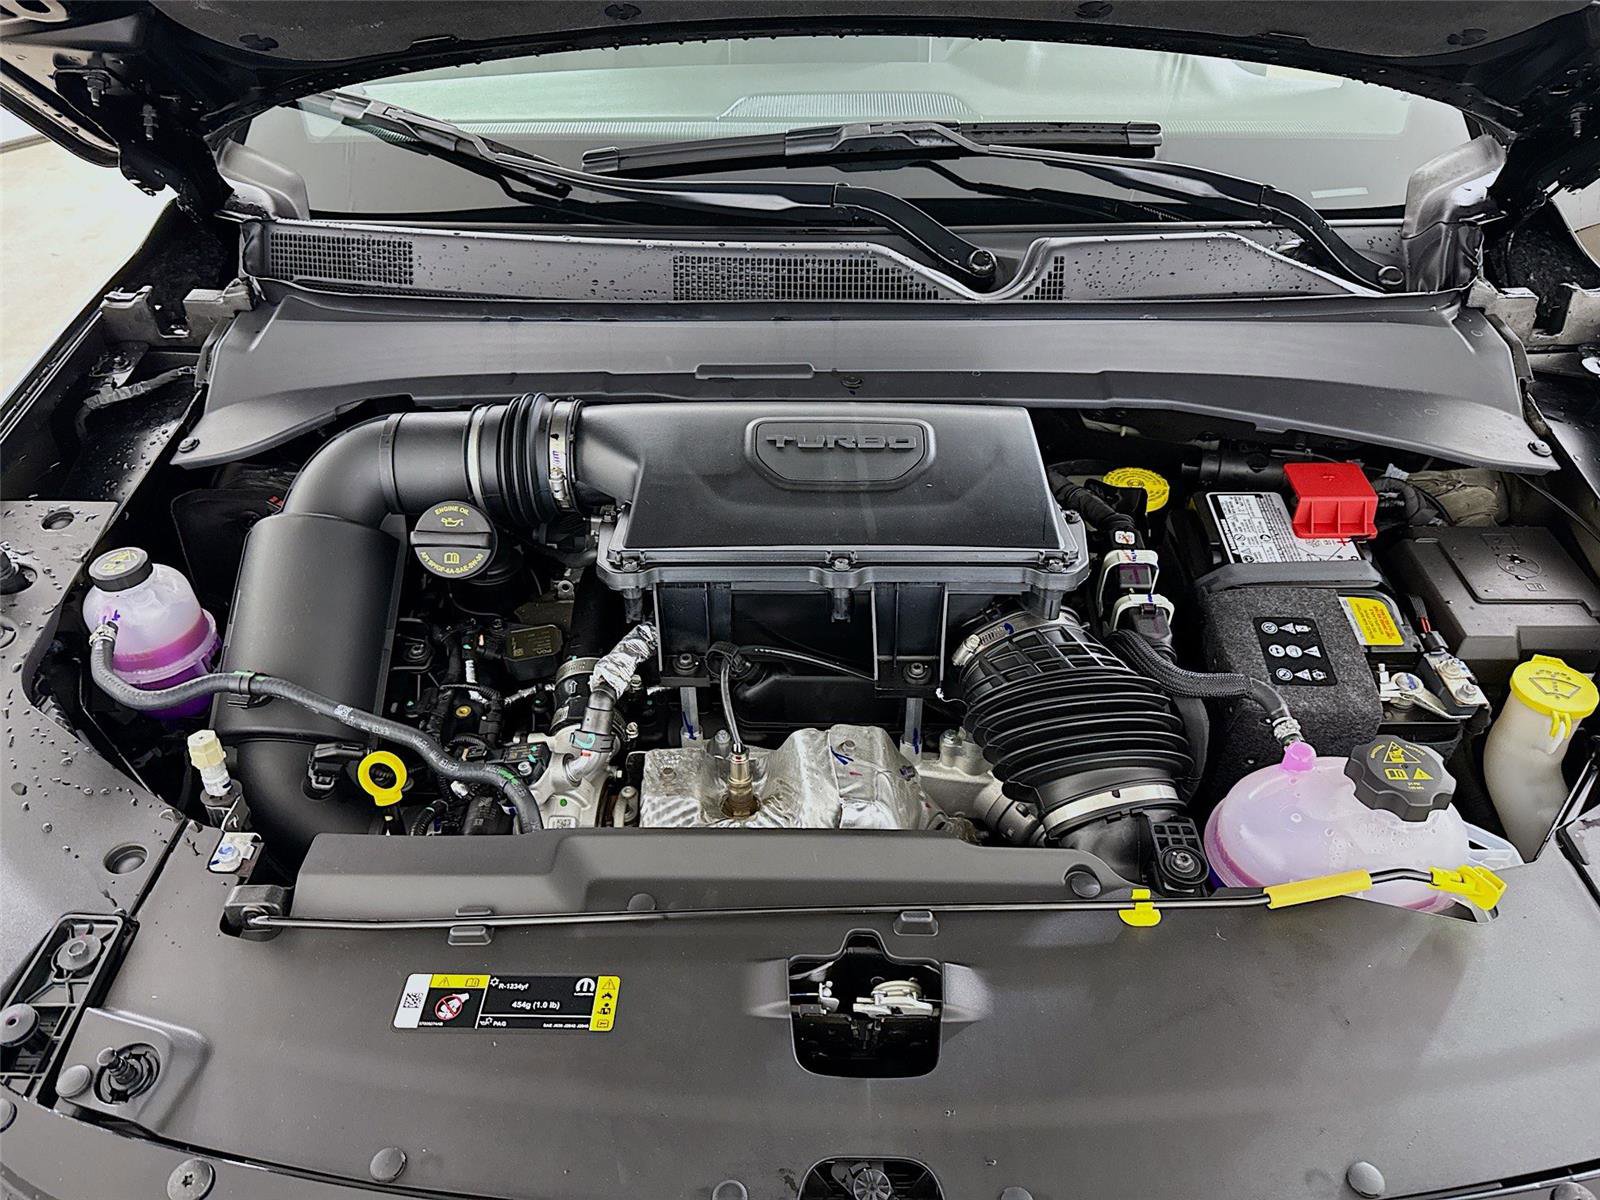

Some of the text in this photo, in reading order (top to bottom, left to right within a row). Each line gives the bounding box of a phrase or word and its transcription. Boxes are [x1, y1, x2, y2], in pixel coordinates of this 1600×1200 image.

[766, 434, 917, 451] TURBO
[434, 505, 470, 517] ENGINE OIL
[498, 983, 529, 991] R-1234yf
[511, 1001, 561, 1010] 454g (1.0 lb)
